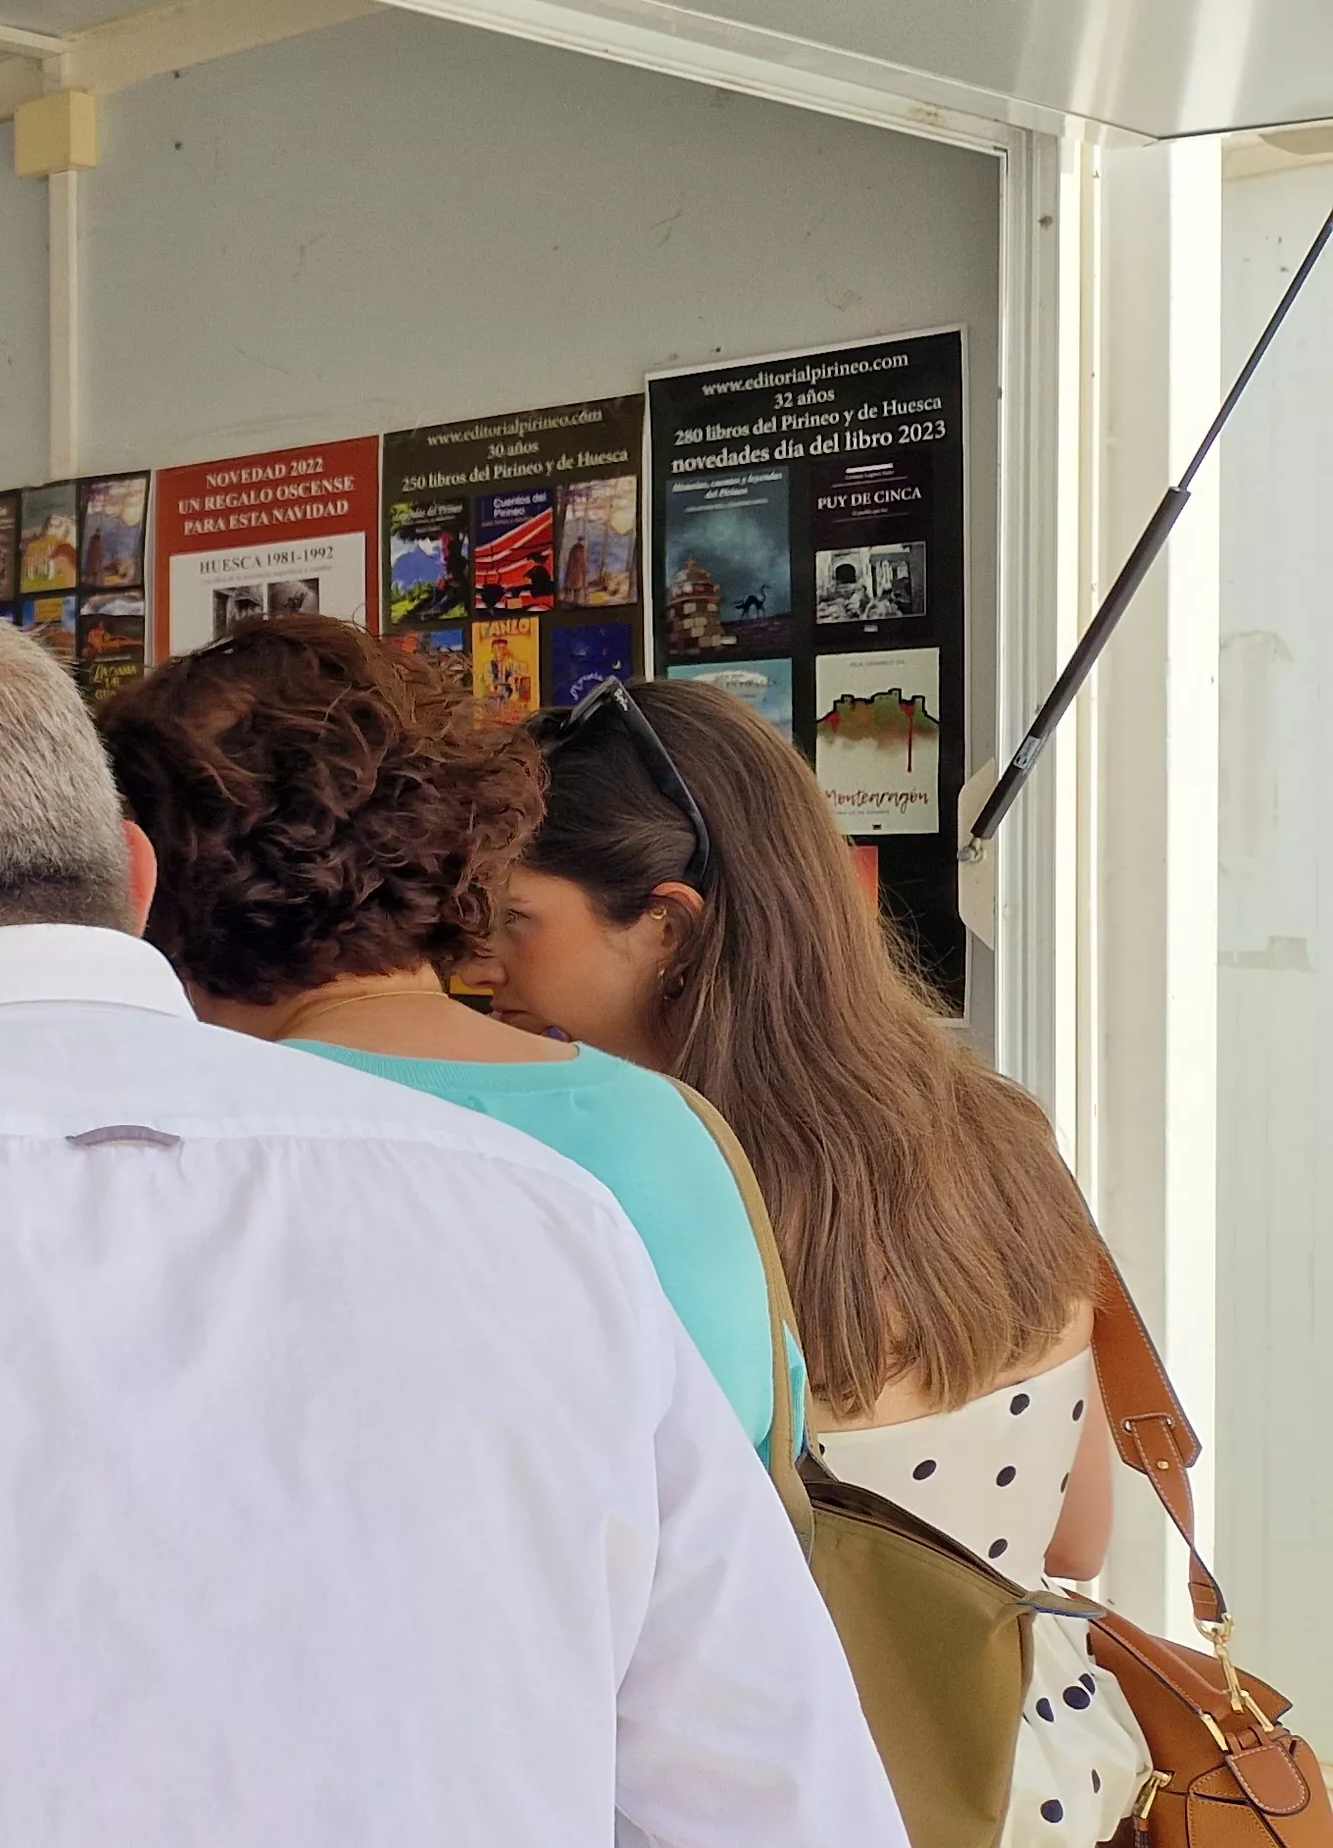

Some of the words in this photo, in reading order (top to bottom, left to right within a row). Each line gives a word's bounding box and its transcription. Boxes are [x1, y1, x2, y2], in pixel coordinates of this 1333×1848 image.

[702, 353, 909, 397] www.editorialpirineo.com
[774, 392, 793, 409] 32
[797, 387, 835, 407] años
[427, 408, 603, 447] www.editorialpirineo.com
[675, 428, 702, 446] 280
[706, 421, 749, 441] libros
[753, 416, 777, 436] del
[781, 410, 840, 431] Pirineo
[844, 411, 852, 426] y
[858, 402, 878, 421] de
[883, 396, 942, 417] Huesca
[487, 443, 504, 460] 30
[506, 439, 539, 457] años
[671, 444, 770, 474] novedades
[774, 438, 804, 461] día
[810, 432, 840, 456] del
[845, 427, 893, 452] libro
[898, 420, 946, 444] 2023
[206, 463, 286, 489] NOVEDAD
[290, 457, 324, 476] 2022
[401, 475, 427, 492] 250
[428, 467, 468, 489] libros
[469, 462, 491, 484] del
[494, 460, 543, 479] Pirineo
[546, 460, 554, 476] y
[557, 453, 573, 471] de
[577, 447, 628, 468] Huesca
[178, 498, 201, 515] UN
[204, 488, 273, 512] REGALO
[276, 476, 354, 501] OSCENSE
[818, 496, 849, 511] PUY
[851, 491, 872, 507] DE
[874, 486, 922, 503] CINCA
[184, 515, 226, 536] PARA
[229, 510, 270, 531] ESTA
[273, 500, 349, 524] NAVIDAD
[199, 556, 262, 575] HUESCA
[266, 546, 334, 567] 1981-1992
